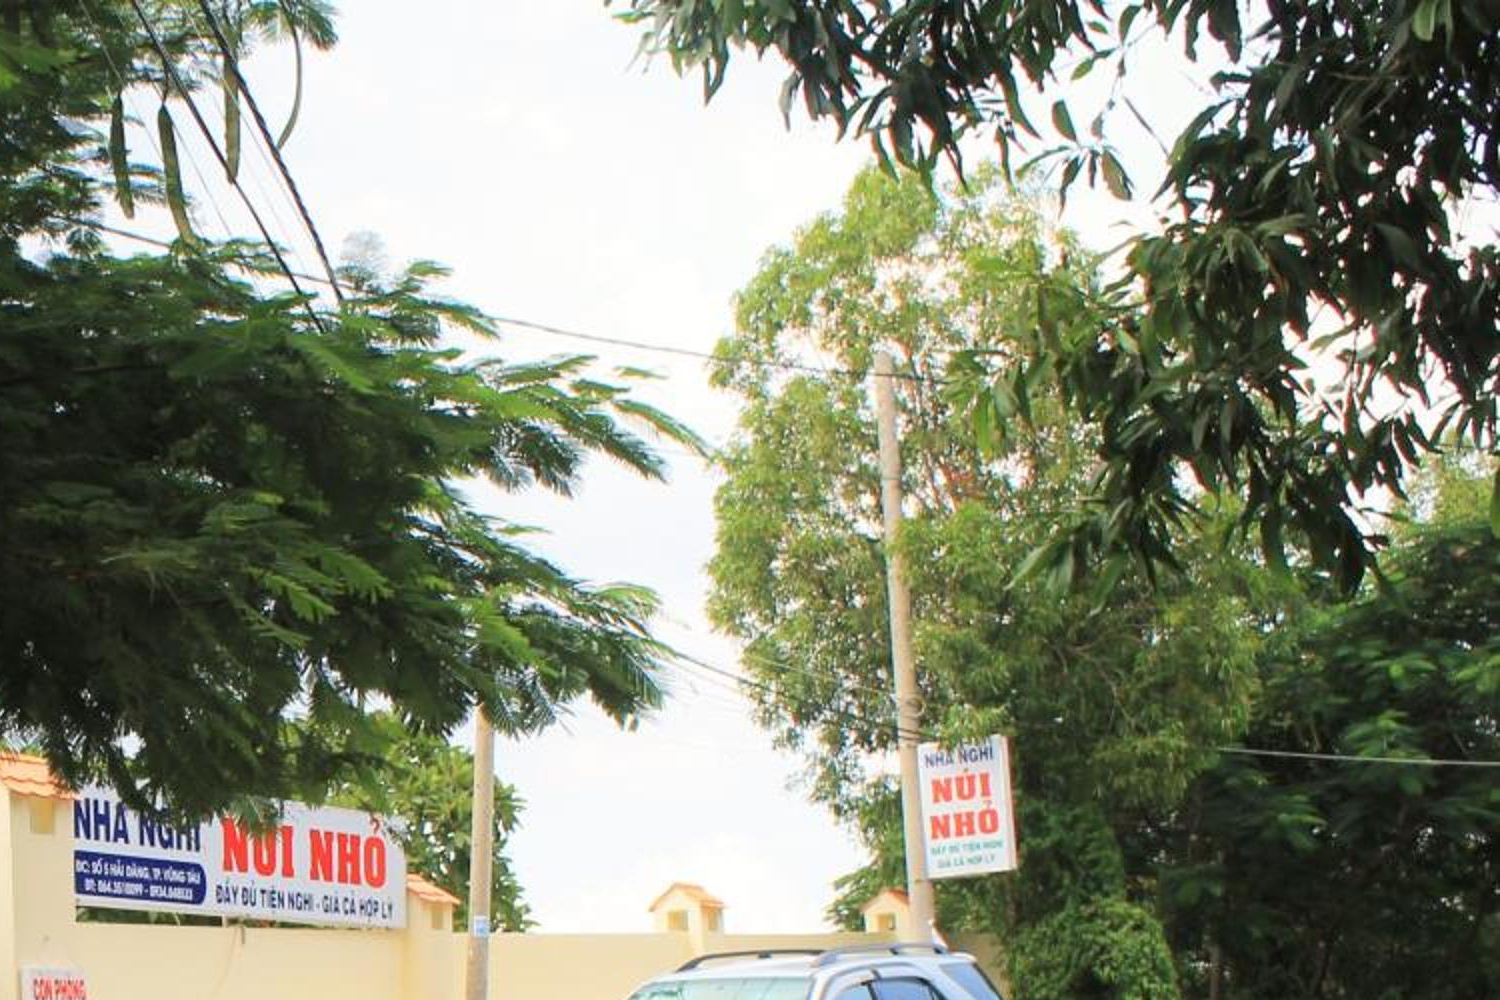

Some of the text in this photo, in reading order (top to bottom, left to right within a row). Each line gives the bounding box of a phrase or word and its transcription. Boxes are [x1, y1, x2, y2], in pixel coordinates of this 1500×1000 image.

[931, 768, 991, 803] NÚI
[930, 800, 999, 840] NHỎ
[310, 817, 387, 889] NHỎ
[241, 880, 257, 907] ĐỦ
[343, 889, 357, 916] CẢ
